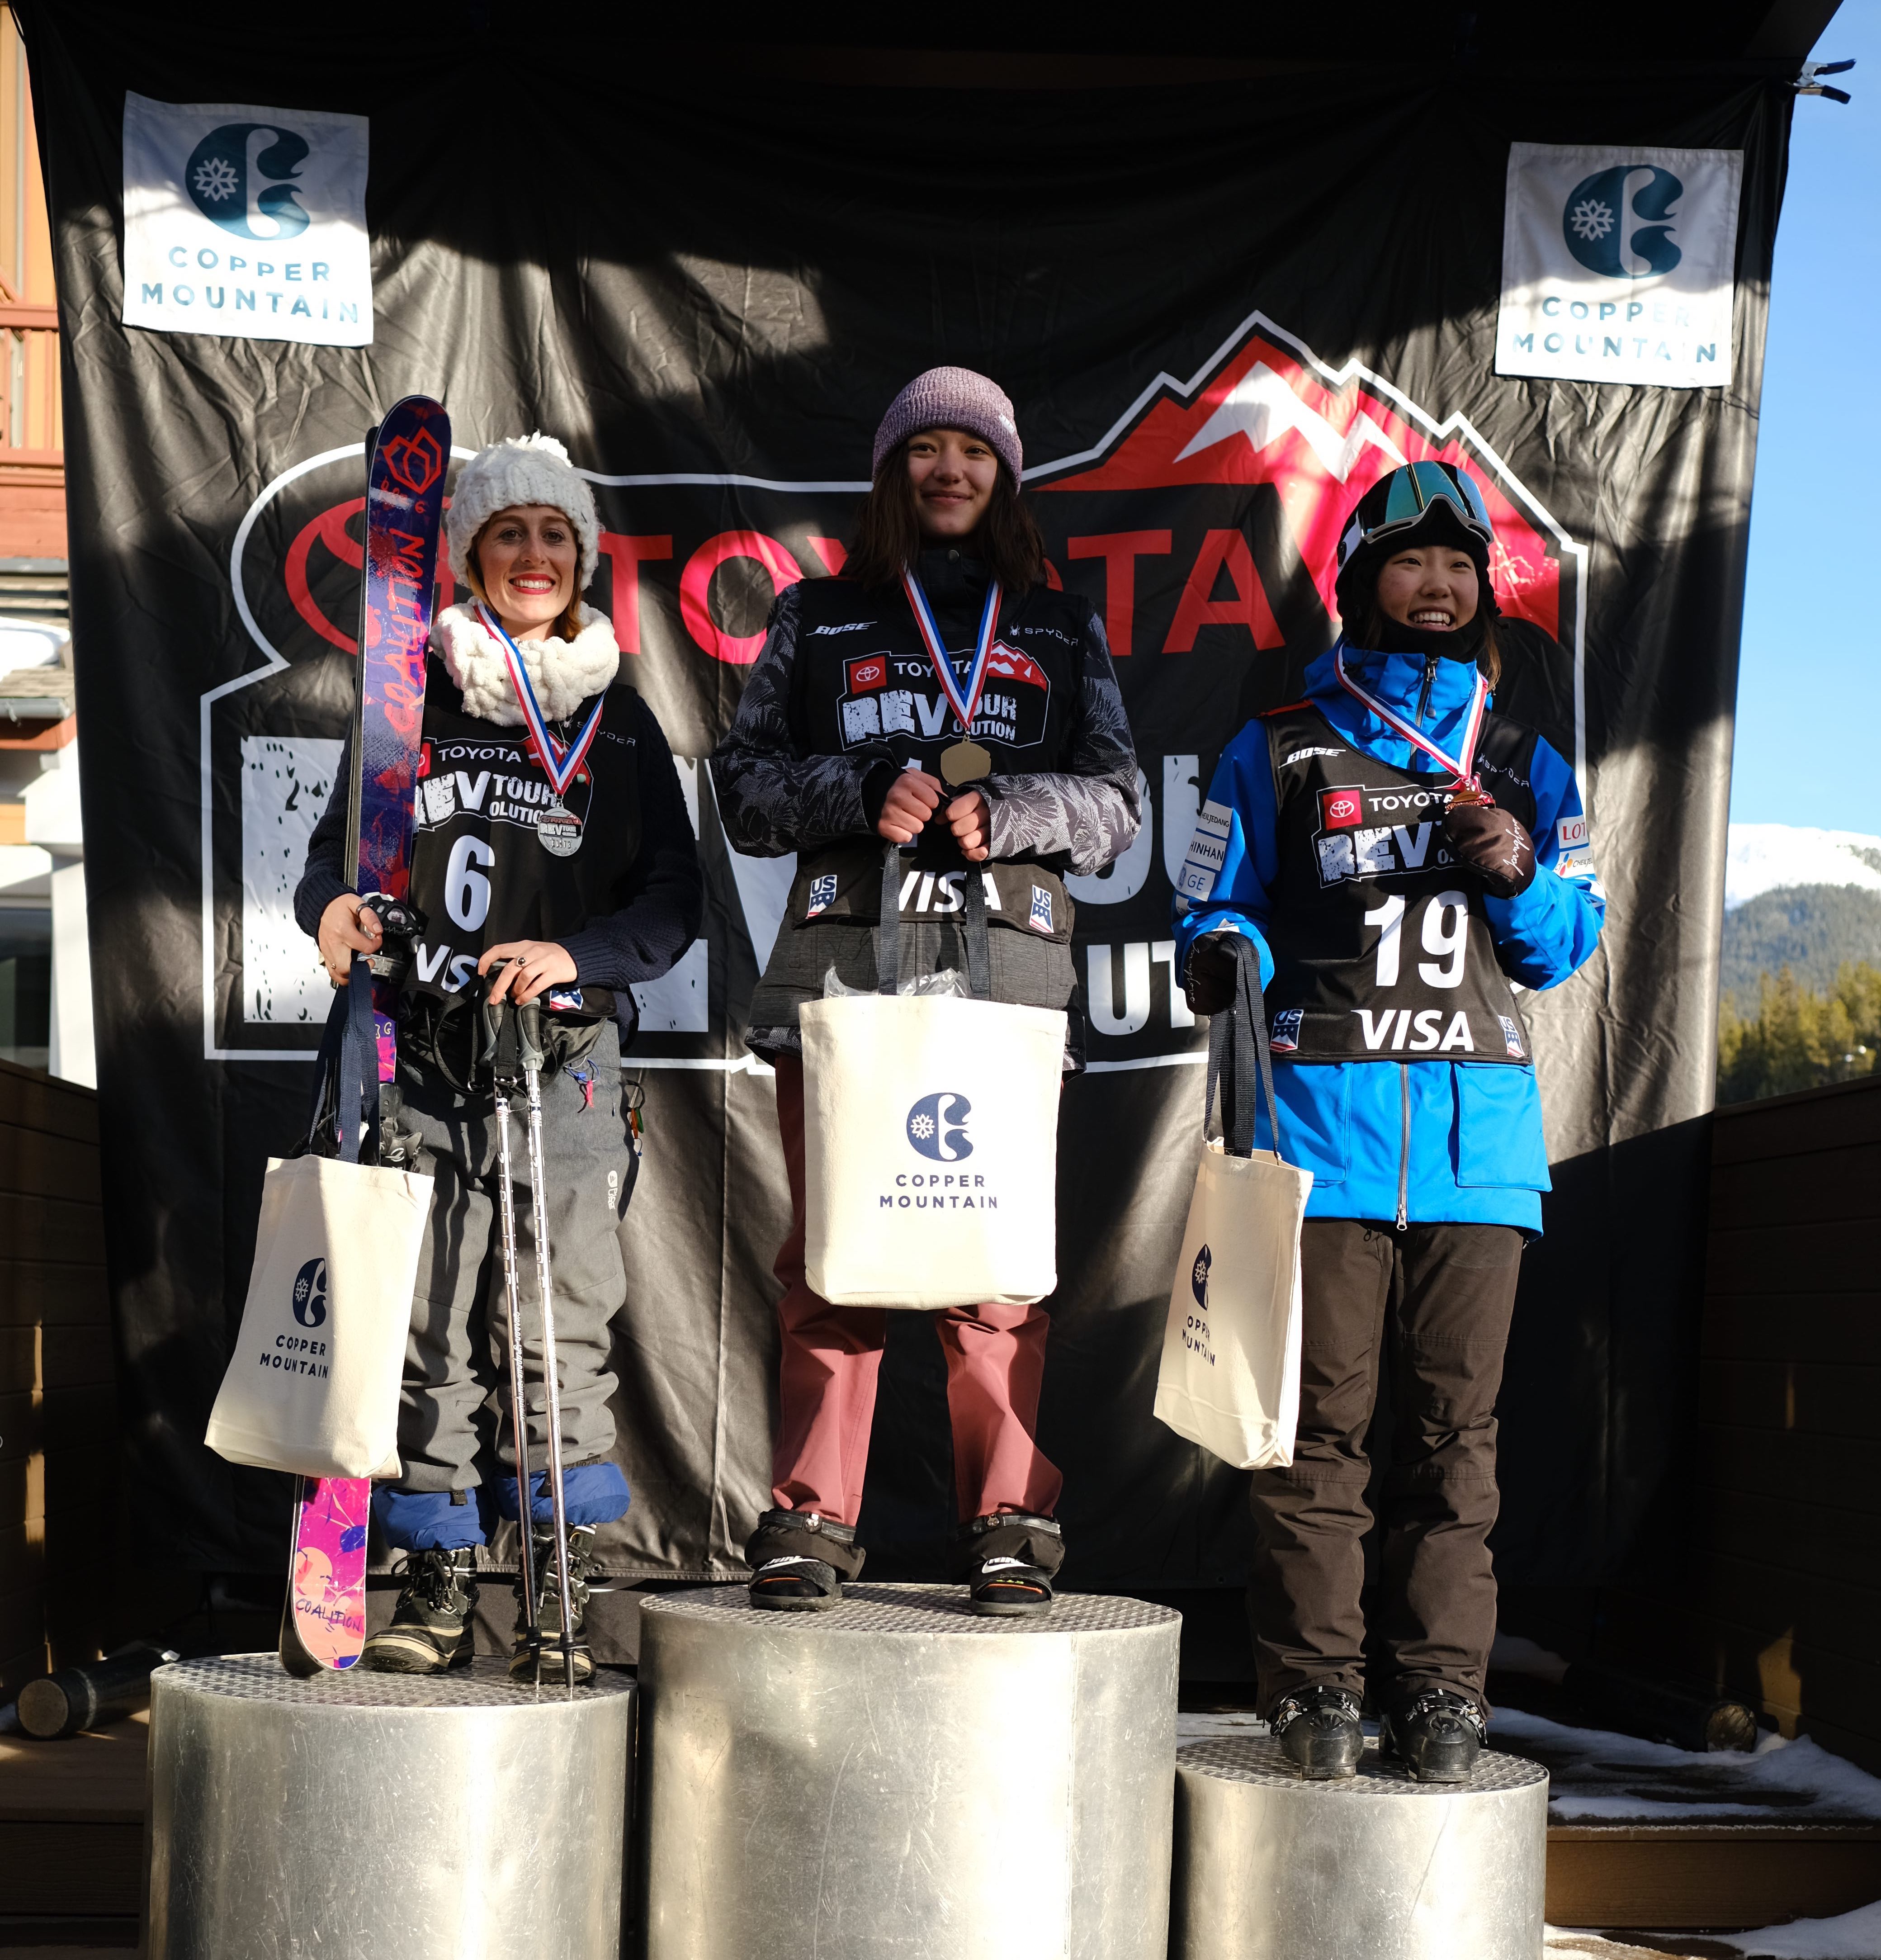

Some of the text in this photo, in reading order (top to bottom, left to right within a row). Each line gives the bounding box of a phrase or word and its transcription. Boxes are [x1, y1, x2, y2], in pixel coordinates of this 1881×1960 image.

[169, 246, 330, 281] COPPER
[141, 283, 358, 323] MOUNTAIN
[1542, 296, 1689, 327] COPPER
[598, 529, 1286, 664] TOTA
[384, 527, 425, 733] COALITION
[806, 621, 878, 635] BOSE
[1025, 628, 1078, 647] SPYDER
[894, 660, 972, 677] TOYTA
[842, 690, 948, 743] REV
[577, 721, 636, 747] SYDER
[438, 745, 522, 764] TOYOTA
[1278, 747, 1346, 768] BOSE
[489, 800, 544, 824] OLUTIO
[1318, 821, 1433, 882] REV
[444, 834, 495, 933] 6
[812, 876, 836, 895] US
[1033, 884, 1052, 905] US
[1187, 874, 1206, 891] GE
[1364, 890, 1470, 989] 19
[1275, 1010, 1301, 1024] US
[1501, 1015, 1515, 1032] US
[1351, 1009, 1474, 1052] VISA
[896, 1174, 985, 1187] COPPER
[879, 1195, 997, 1208] MOUNTAIN
[276, 1335, 326, 1356] COPPER
[260, 1353, 329, 1378] MOUNTAIN
[296, 1598, 362, 1631] COALITION
